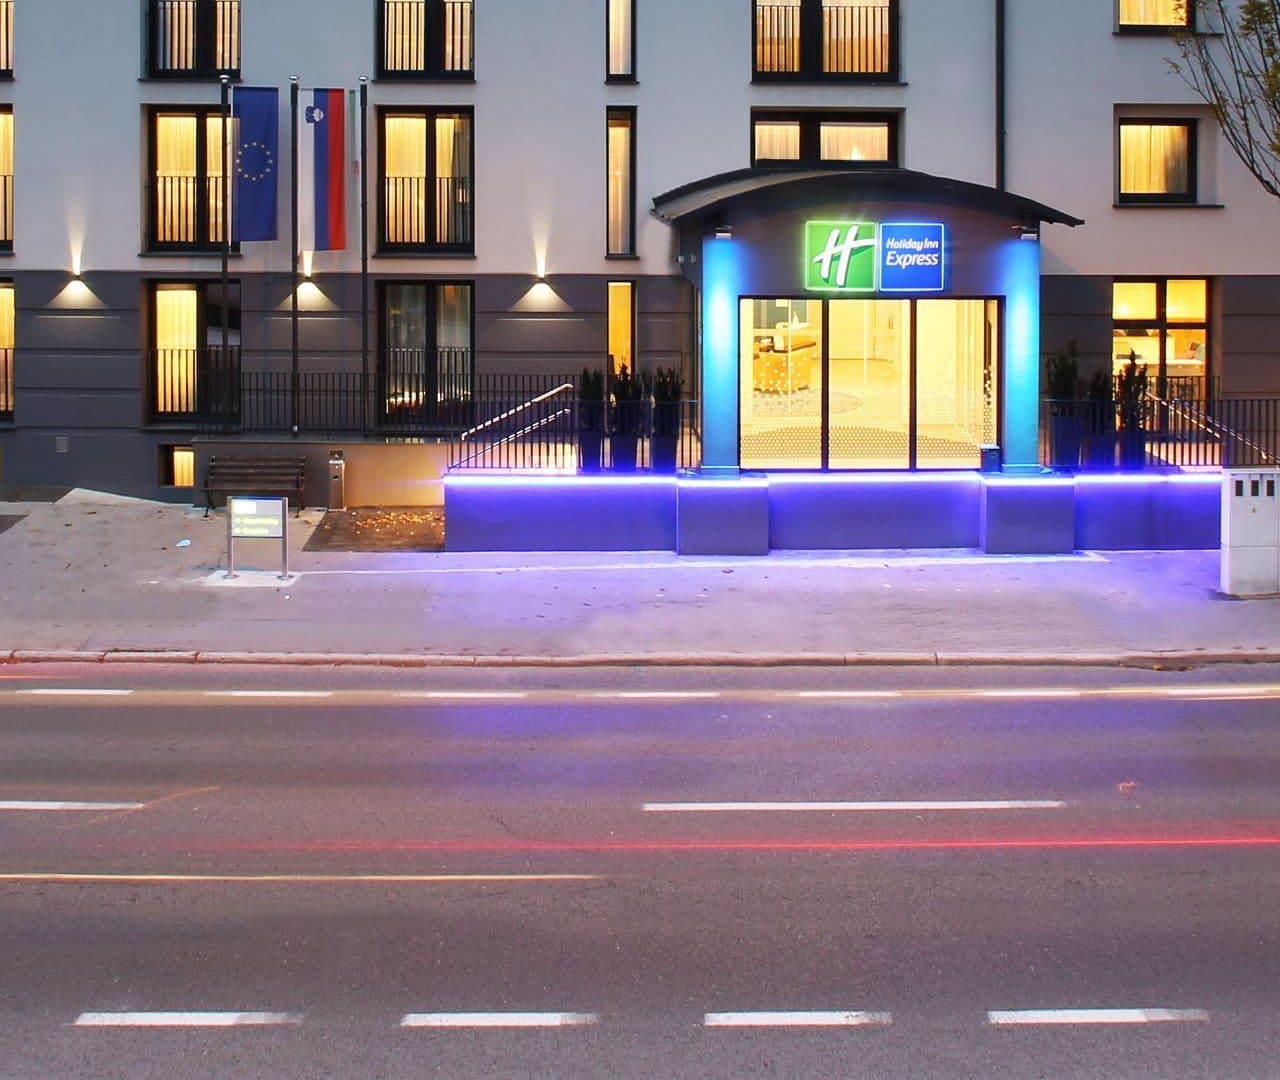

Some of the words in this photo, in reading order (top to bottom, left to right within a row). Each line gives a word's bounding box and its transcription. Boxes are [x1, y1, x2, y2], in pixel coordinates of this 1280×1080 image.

[886, 237, 923, 251] Holiday
[924, 237, 939, 249] Inn
[886, 251, 939, 269] Express
